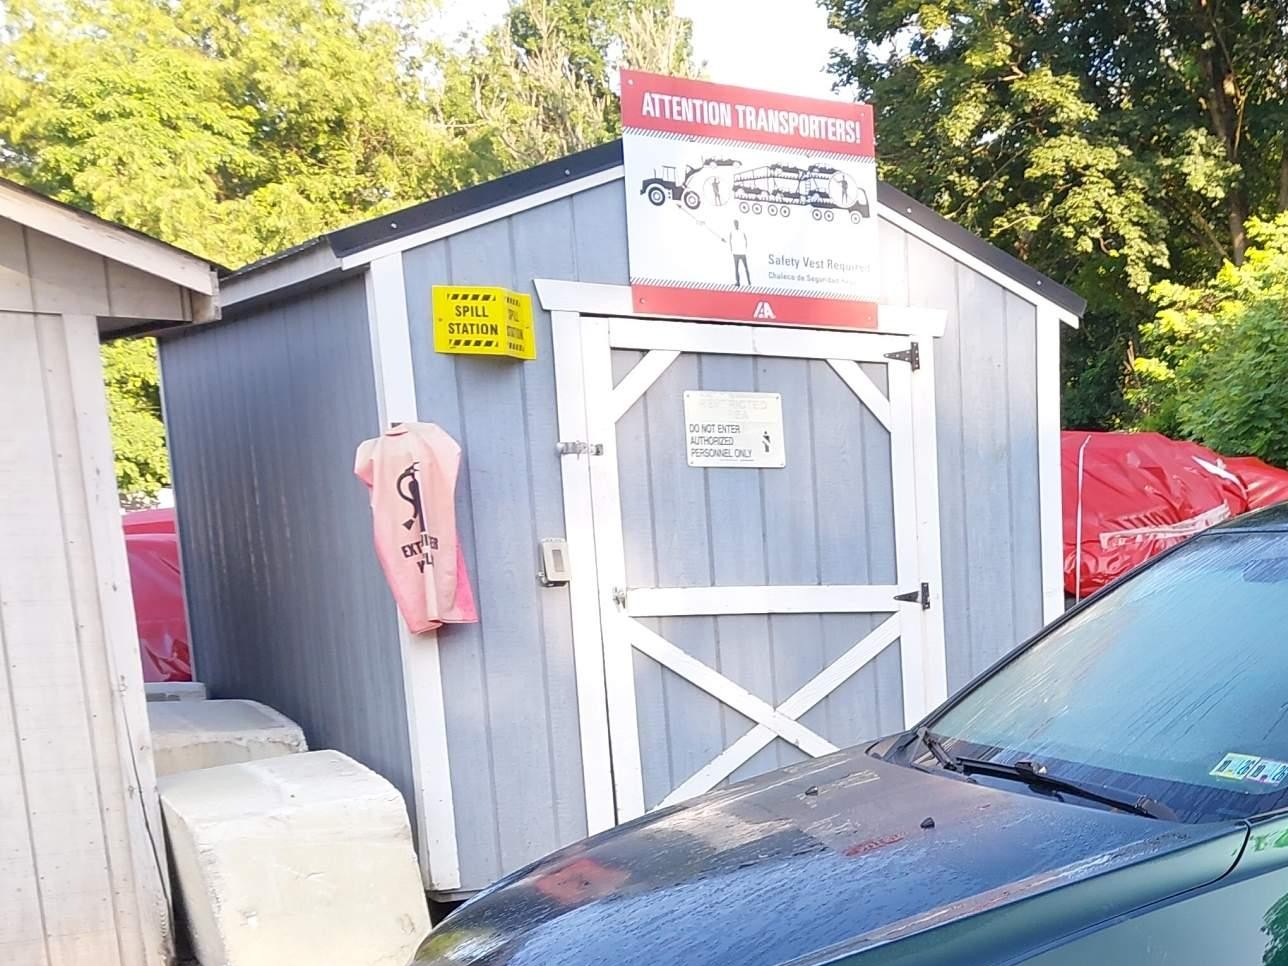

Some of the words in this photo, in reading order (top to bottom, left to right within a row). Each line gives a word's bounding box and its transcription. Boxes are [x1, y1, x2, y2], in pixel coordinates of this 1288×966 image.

[642, 92, 731, 128] ATTENTION
[735, 105, 861, 144] TRANSPORTERS!
[768, 254, 800, 270] Safety
[803, 256, 824, 269] Vest
[455, 304, 489, 318] SPILL
[448, 322, 498, 335] STATION
[689, 424, 700, 433] DO
[702, 424, 715, 433] NOT
[717, 424, 741, 434] ENTER
[690, 436, 735, 446] AUTHORIZED
[691, 448, 734, 458] PERSONNEL
[734, 449, 752, 458] ONLY
